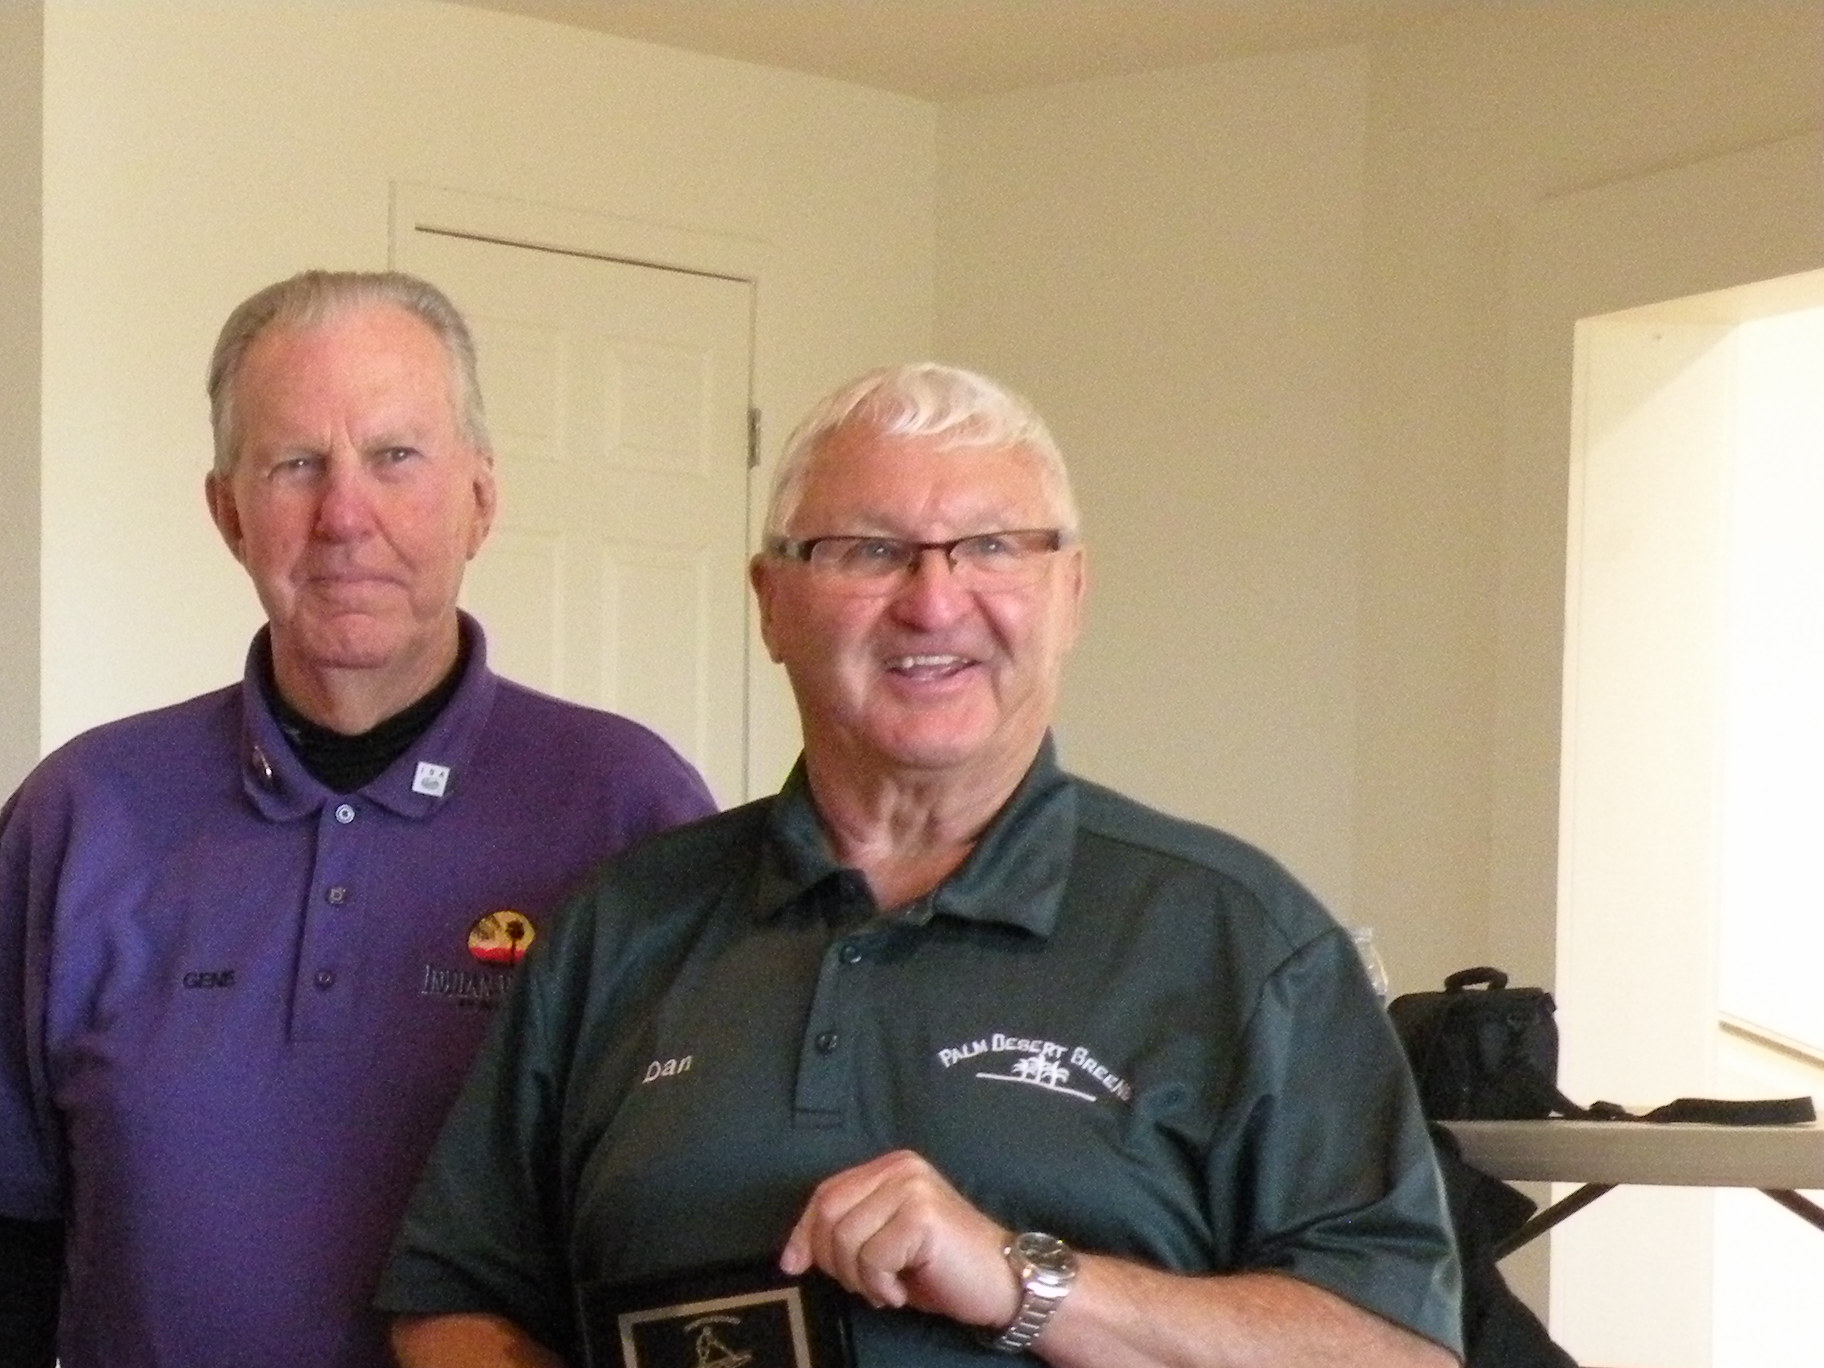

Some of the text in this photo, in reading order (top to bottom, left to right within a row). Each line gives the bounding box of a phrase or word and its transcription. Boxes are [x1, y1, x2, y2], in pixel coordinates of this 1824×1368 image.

[182, 970, 237, 989] GENE
[937, 1039, 988, 1068] PALM
[992, 1033, 1068, 1059] DESERT
[642, 1055, 692, 1084] Dan
